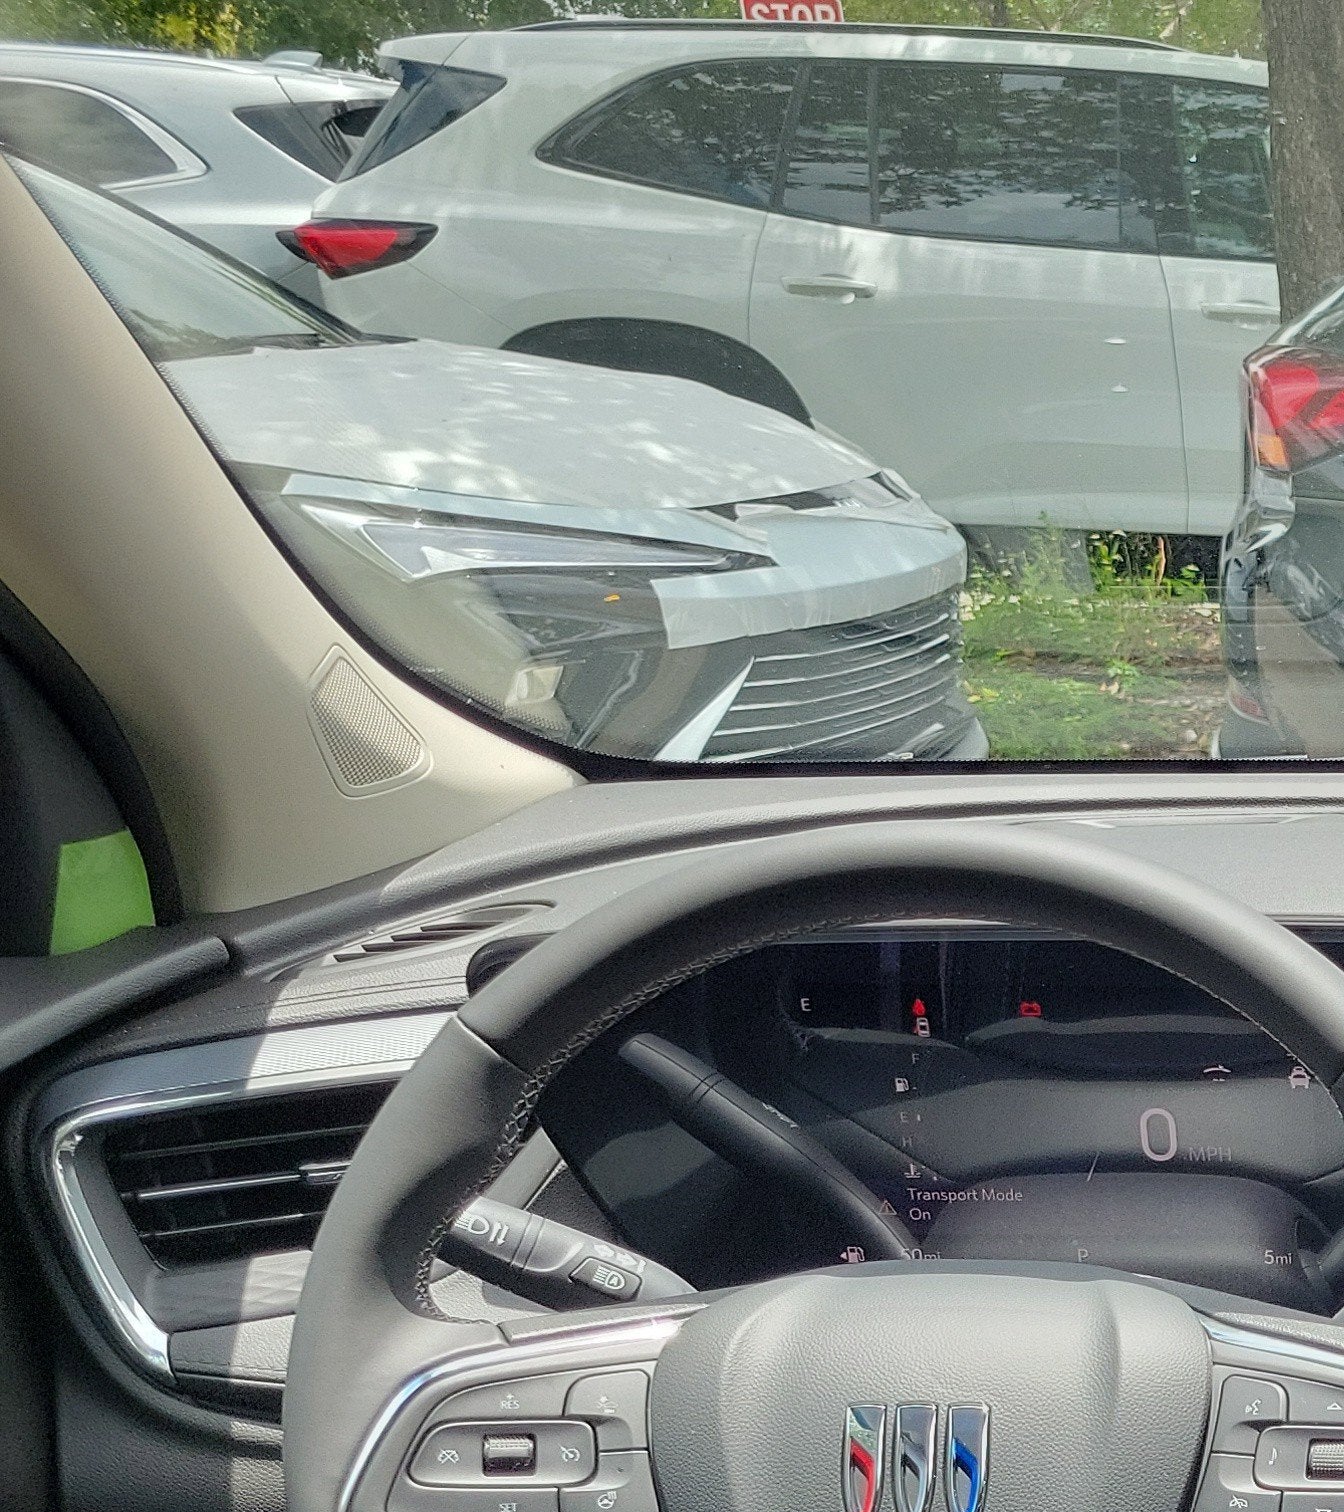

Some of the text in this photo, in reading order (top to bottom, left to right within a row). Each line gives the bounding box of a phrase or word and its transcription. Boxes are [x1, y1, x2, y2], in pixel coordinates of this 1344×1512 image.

[801, 998, 811, 1012] E
[1139, 1107, 1232, 1162] 0 MPH
[906, 1188, 1023, 1204] Transport Mode
[909, 1208, 931, 1221] On
[1264, 1250, 1293, 1266] 5mi
